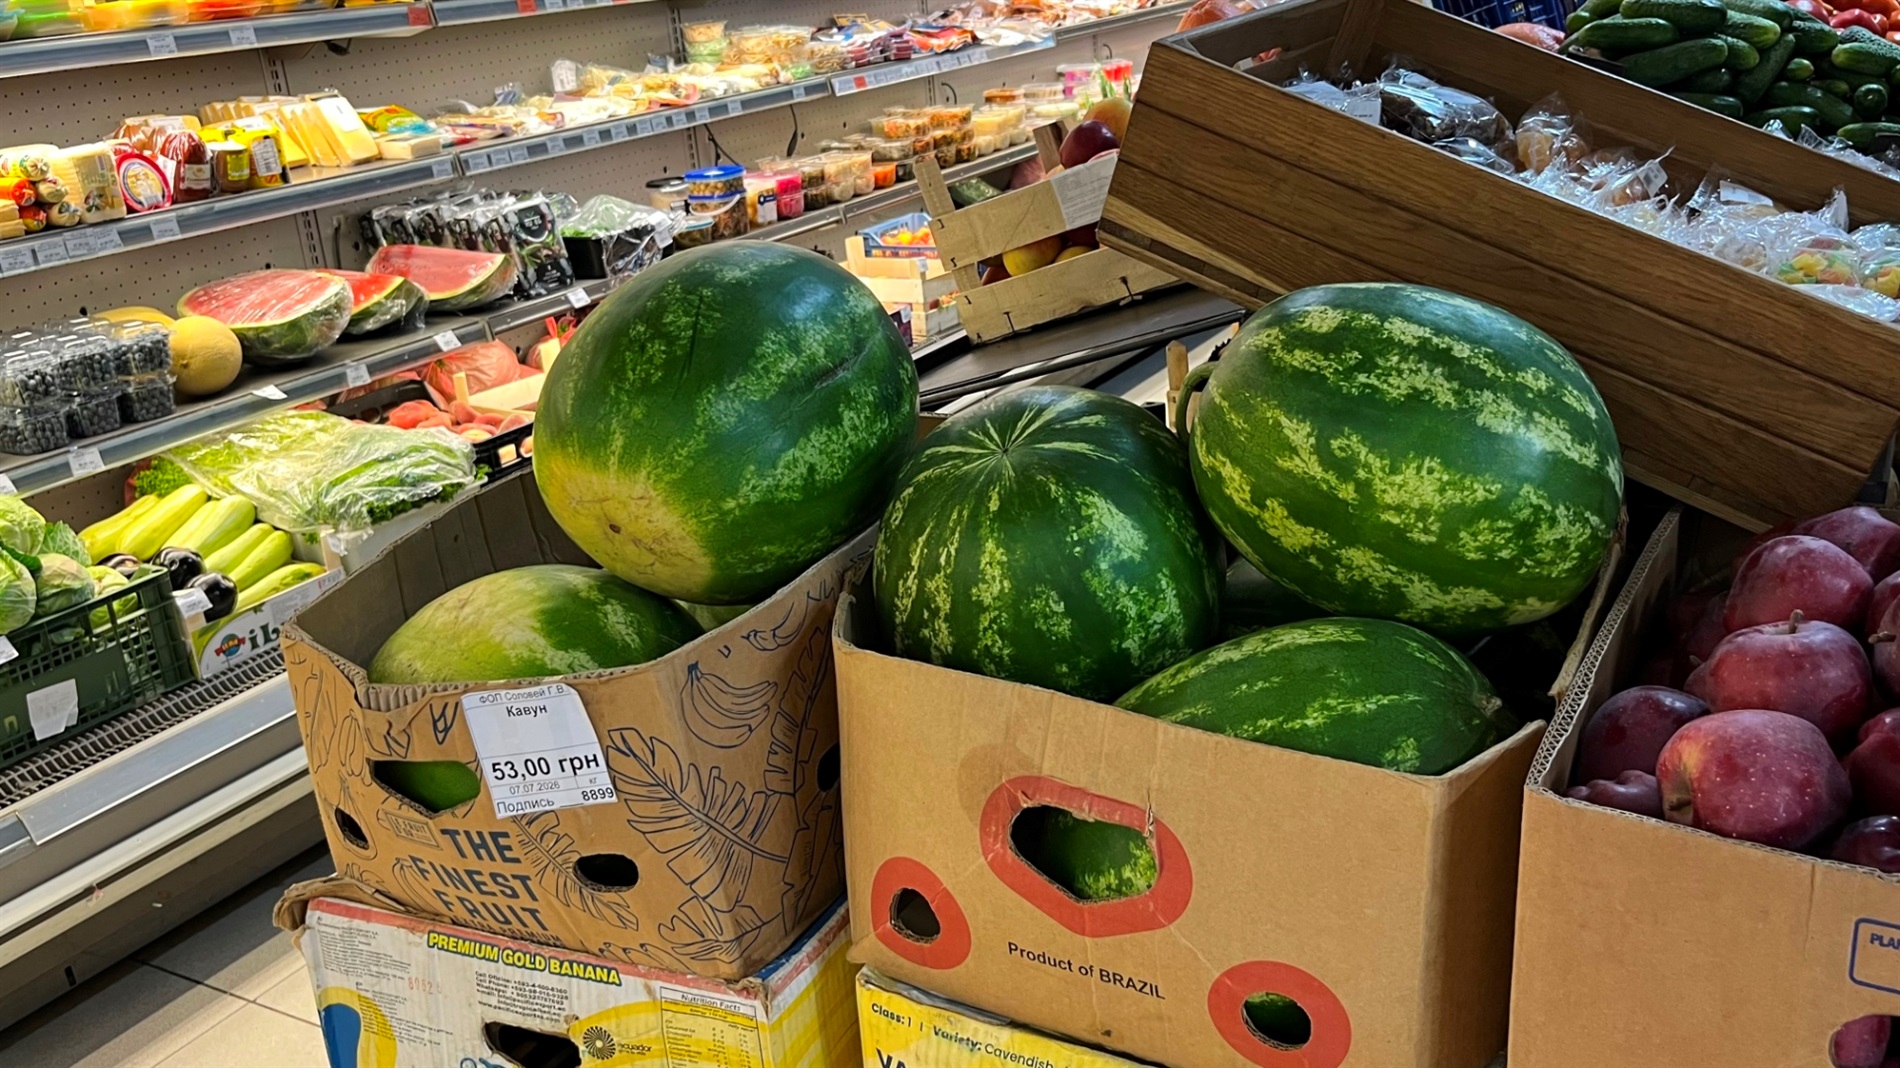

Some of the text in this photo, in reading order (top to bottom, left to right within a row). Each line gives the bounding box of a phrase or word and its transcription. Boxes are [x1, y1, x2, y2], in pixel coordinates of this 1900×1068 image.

[479, 693, 502, 704] ФОП
[504, 688, 546, 701] Соловей
[506, 704, 548, 717] Кавун
[491, 753, 600, 781] 53,00 грн
[588, 776, 597, 785] кг
[497, 798, 555, 814] Подпись
[581, 787, 614, 801] 8899
[439, 829, 522, 864] THE
[408, 854, 539, 903] FINEST
[432, 888, 548, 932] FRUIT
[428, 931, 500, 963] PREMIUM
[501, 947, 547, 972] GOLD
[549, 958, 622, 986] BANANA
[1008, 941, 1165, 1000] Product of BRAZIL
[681, 994, 718, 1007] Nutrition
[720, 1001, 741, 1012] Facts
[871, 1003, 905, 1025] Class:
[933, 1025, 982, 1053] Variety:
[984, 1043, 1054, 1068] Cavendish
